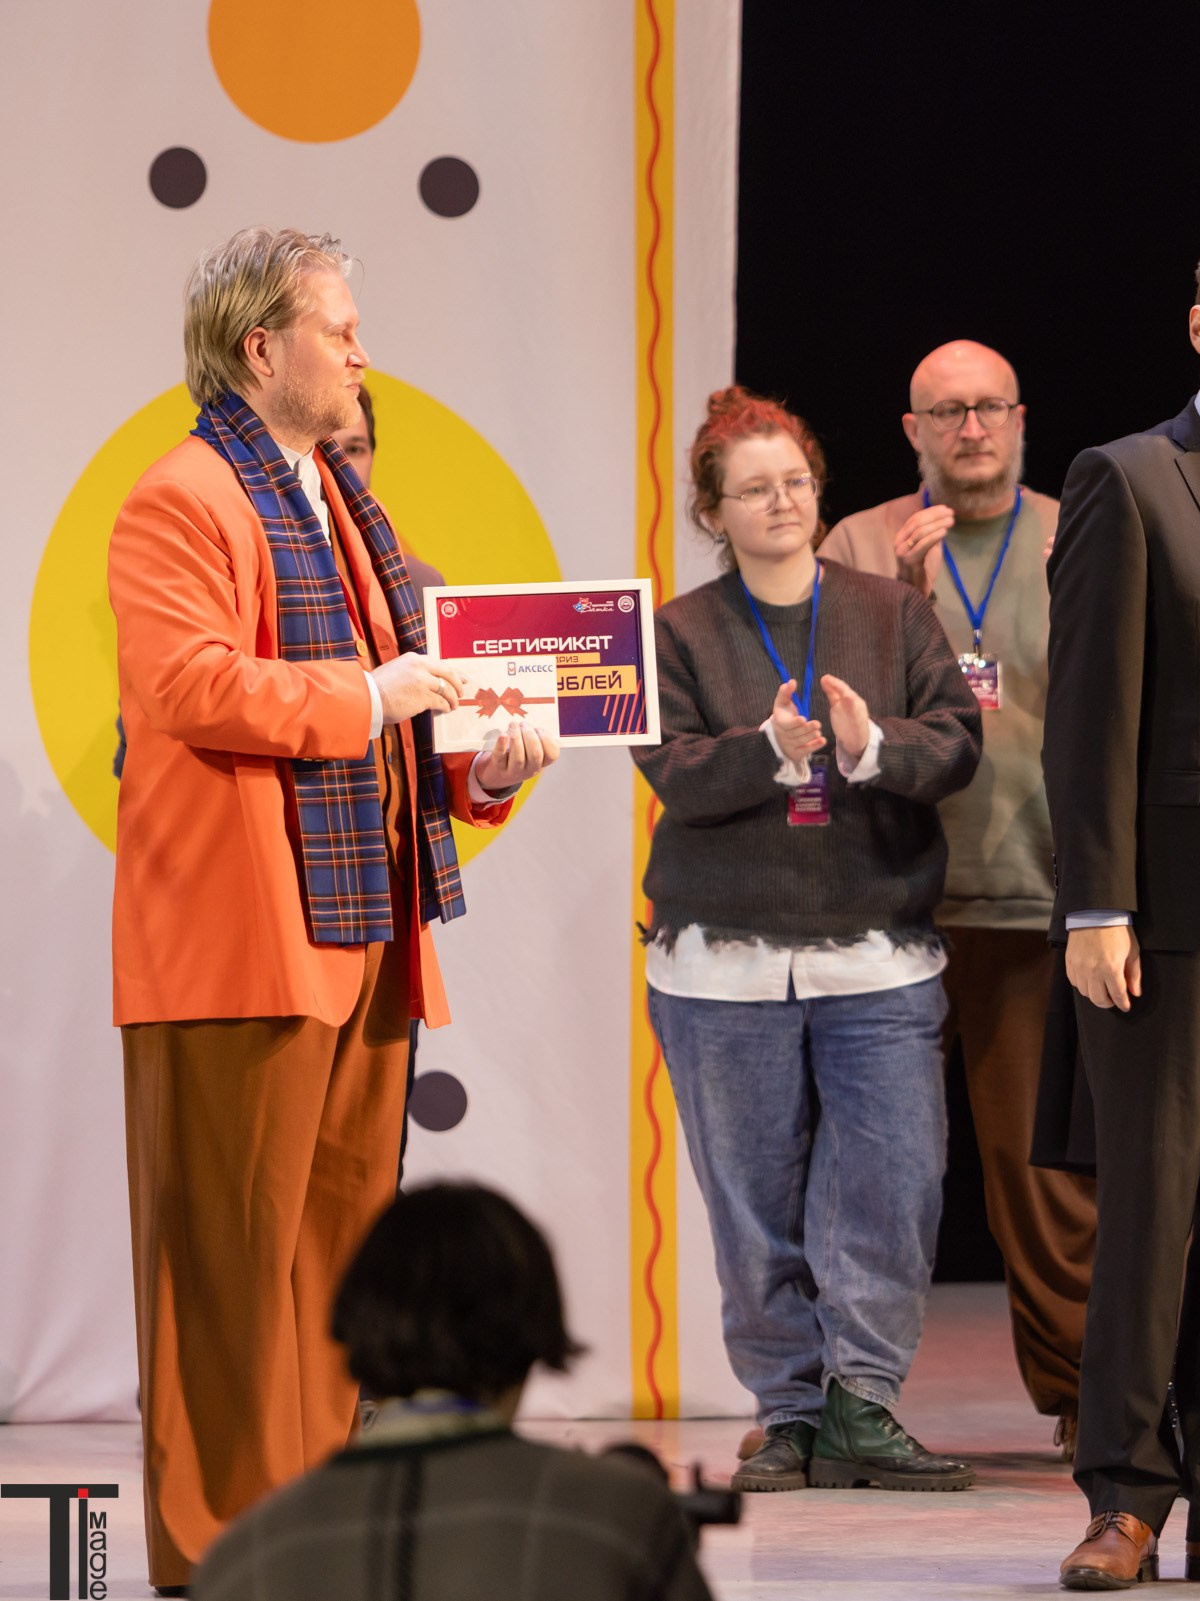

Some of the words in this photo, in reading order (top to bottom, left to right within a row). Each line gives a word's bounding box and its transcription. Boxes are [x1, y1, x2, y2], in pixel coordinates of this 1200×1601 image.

[473, 635, 613, 654] СЕРТИФИКАТ
[518, 664, 553, 673] АКСЕСС
[557, 671, 622, 691] УБЛЕЙ
